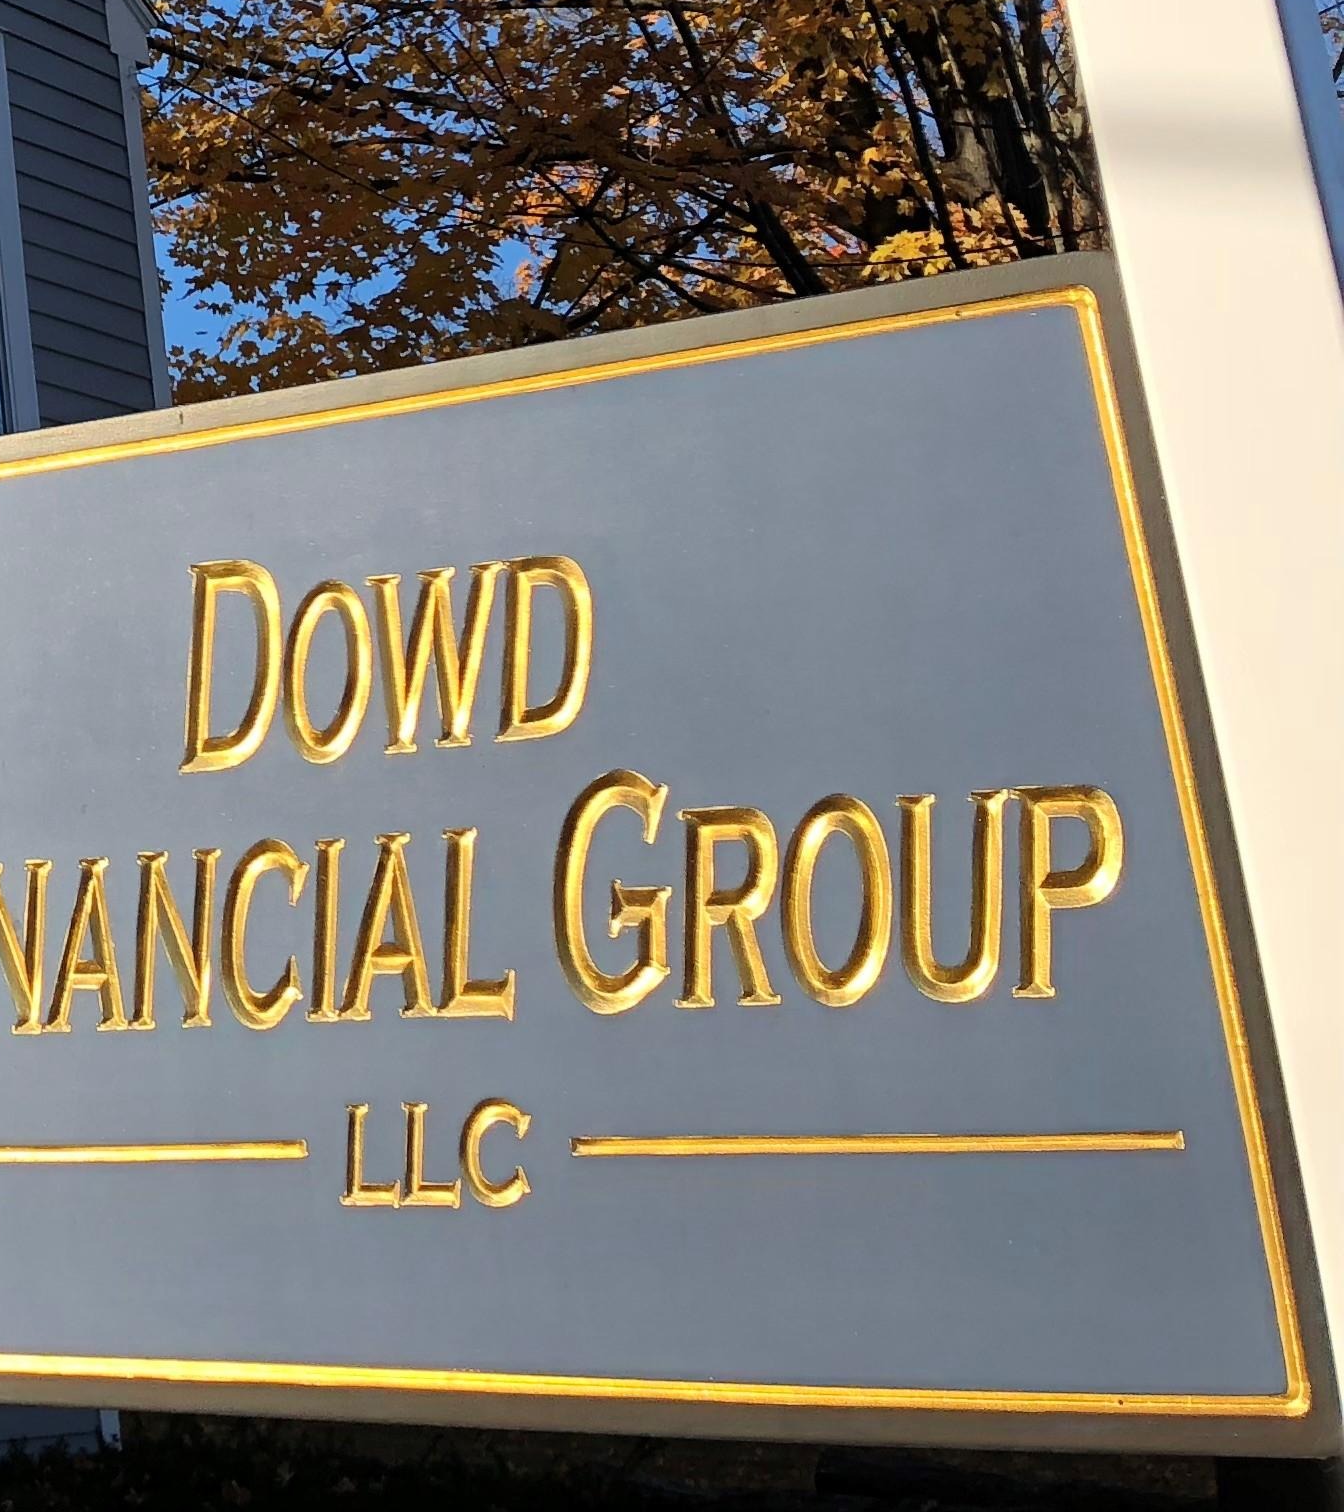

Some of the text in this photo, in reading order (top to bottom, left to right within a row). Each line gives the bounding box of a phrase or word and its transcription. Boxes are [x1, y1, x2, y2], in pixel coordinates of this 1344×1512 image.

[179, 555, 593, 775] DOWD
[553, 768, 1125, 1015] GROUP
[338, 1097, 532, 1209] LLC
